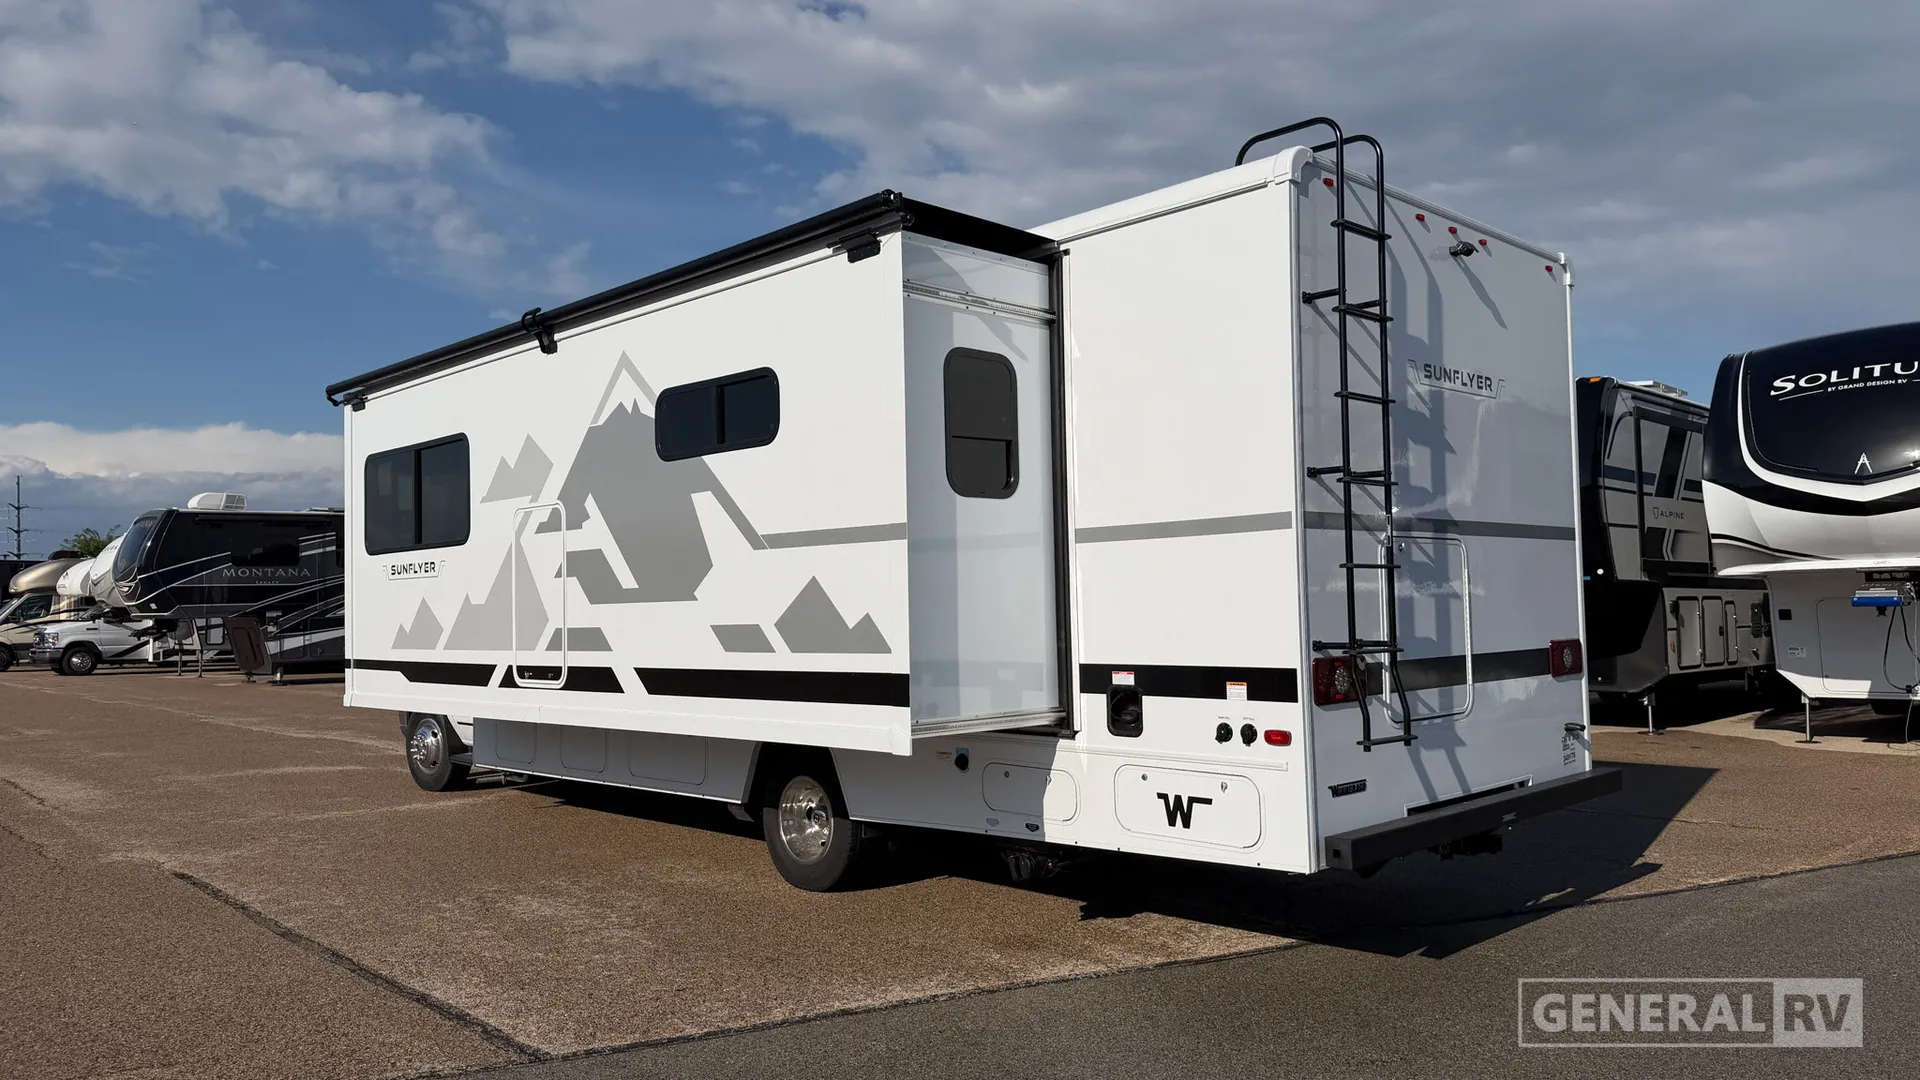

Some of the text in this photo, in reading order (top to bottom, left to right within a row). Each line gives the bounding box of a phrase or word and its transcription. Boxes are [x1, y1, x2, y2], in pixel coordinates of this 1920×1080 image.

[1423, 363, 1493, 392] SUNFLYER
[1770, 361, 1919, 396] SOLITU
[1838, 382, 1865, 390] GRAND
[1866, 379, 1896, 387] DESIGN
[1659, 510, 1685, 520] ALPINE
[222, 568, 311, 577] MONTANA
[391, 561, 436, 575] SUNFLYER
